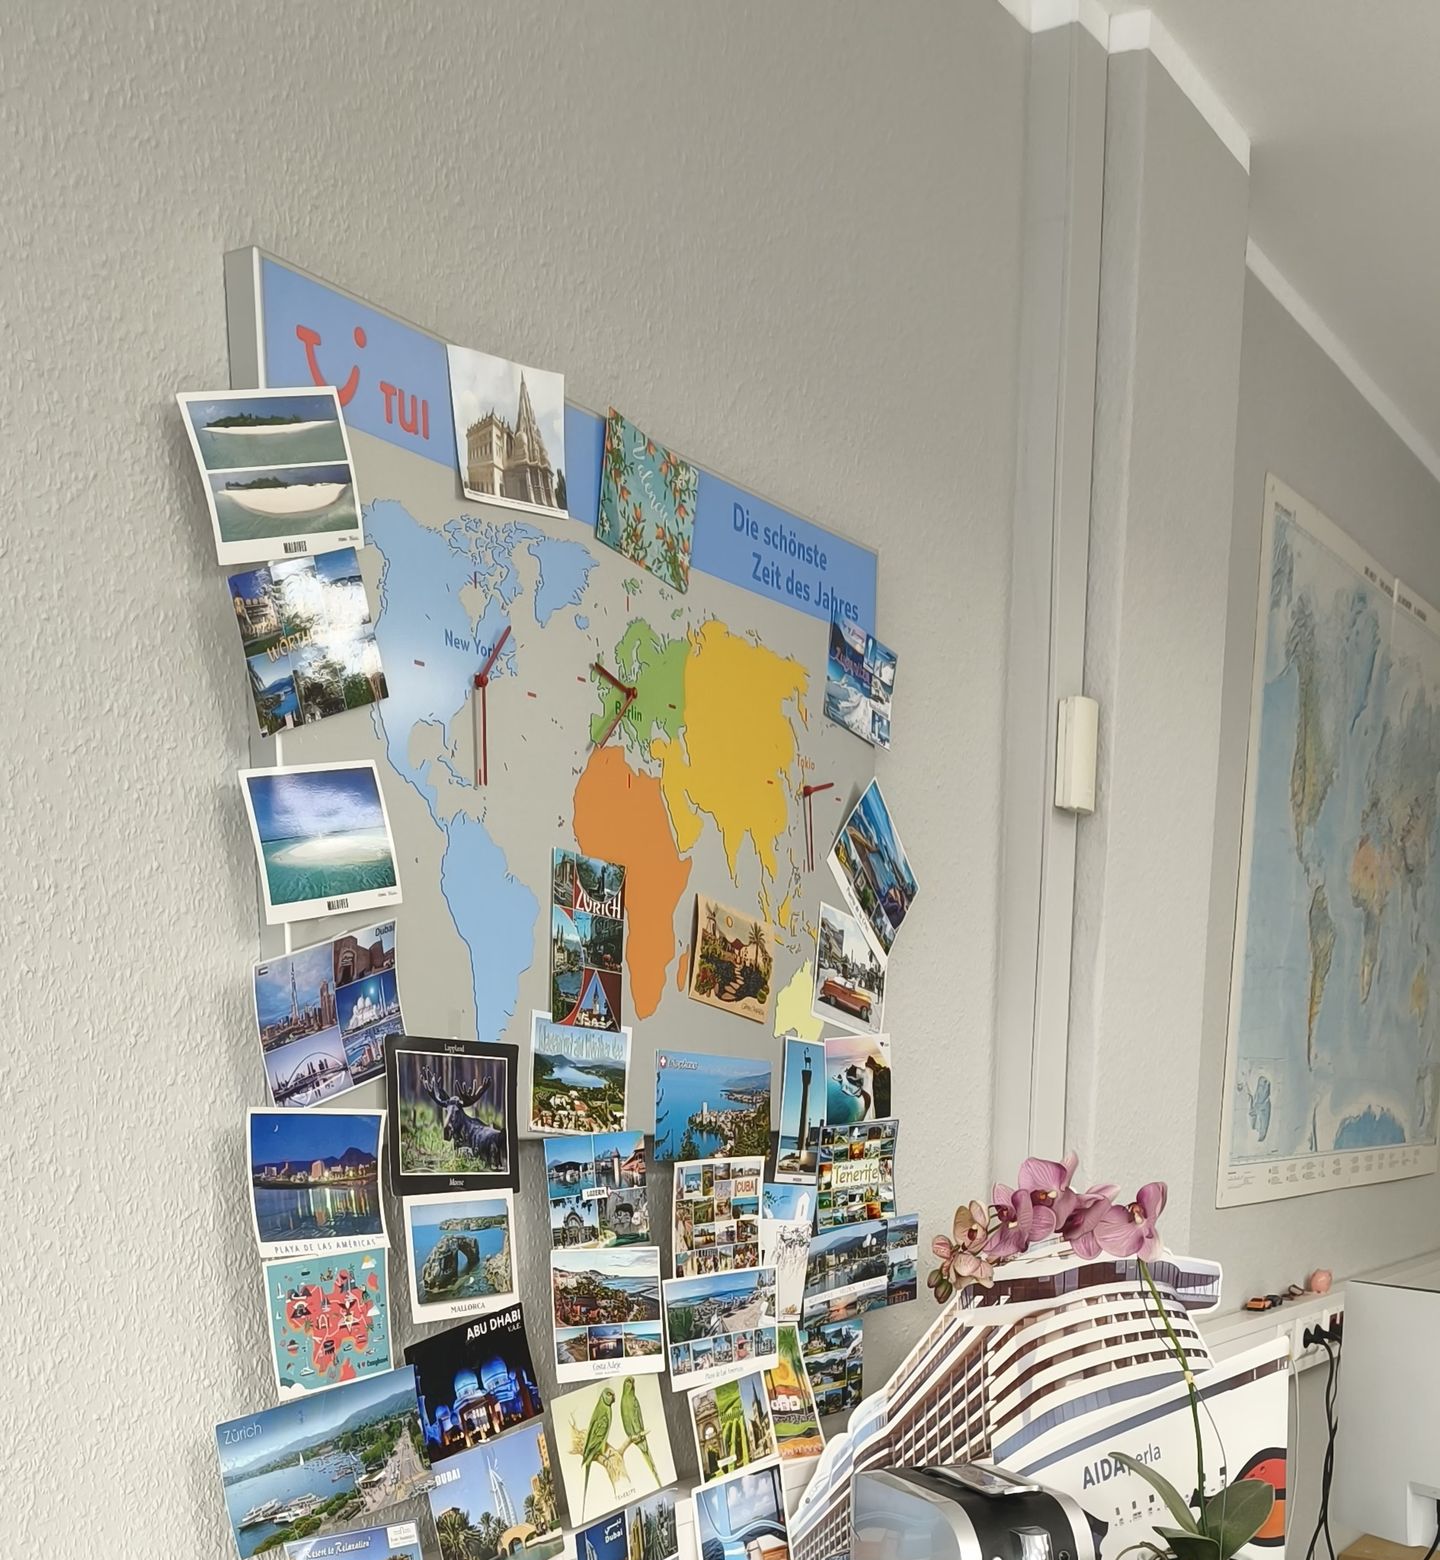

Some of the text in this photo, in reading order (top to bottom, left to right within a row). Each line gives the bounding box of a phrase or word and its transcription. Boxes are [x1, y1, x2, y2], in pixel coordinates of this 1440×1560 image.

[379, 380, 429, 440] TUI
[733, 502, 828, 571] Die schönste
[283, 541, 307, 553] MALDIVES
[752, 552, 859, 622] Zeit des Jahres
[444, 628, 470, 652] New
[797, 753, 815, 770] Tokio
[327, 898, 349, 910] MALDIVES
[833, 1162, 879, 1184] Tenerife
[737, 1180, 755, 1193] CUBA
[274, 1246, 300, 1254] PLAYA
[318, 1242, 332, 1250] LAS
[450, 1302, 486, 1314] MALLORCA
[466, 1308, 521, 1341] ABU DHABI
[224, 1423, 262, 1446] Zürich
[435, 1468, 461, 1486] DUBAI
[605, 1528, 623, 1544] Dubai
